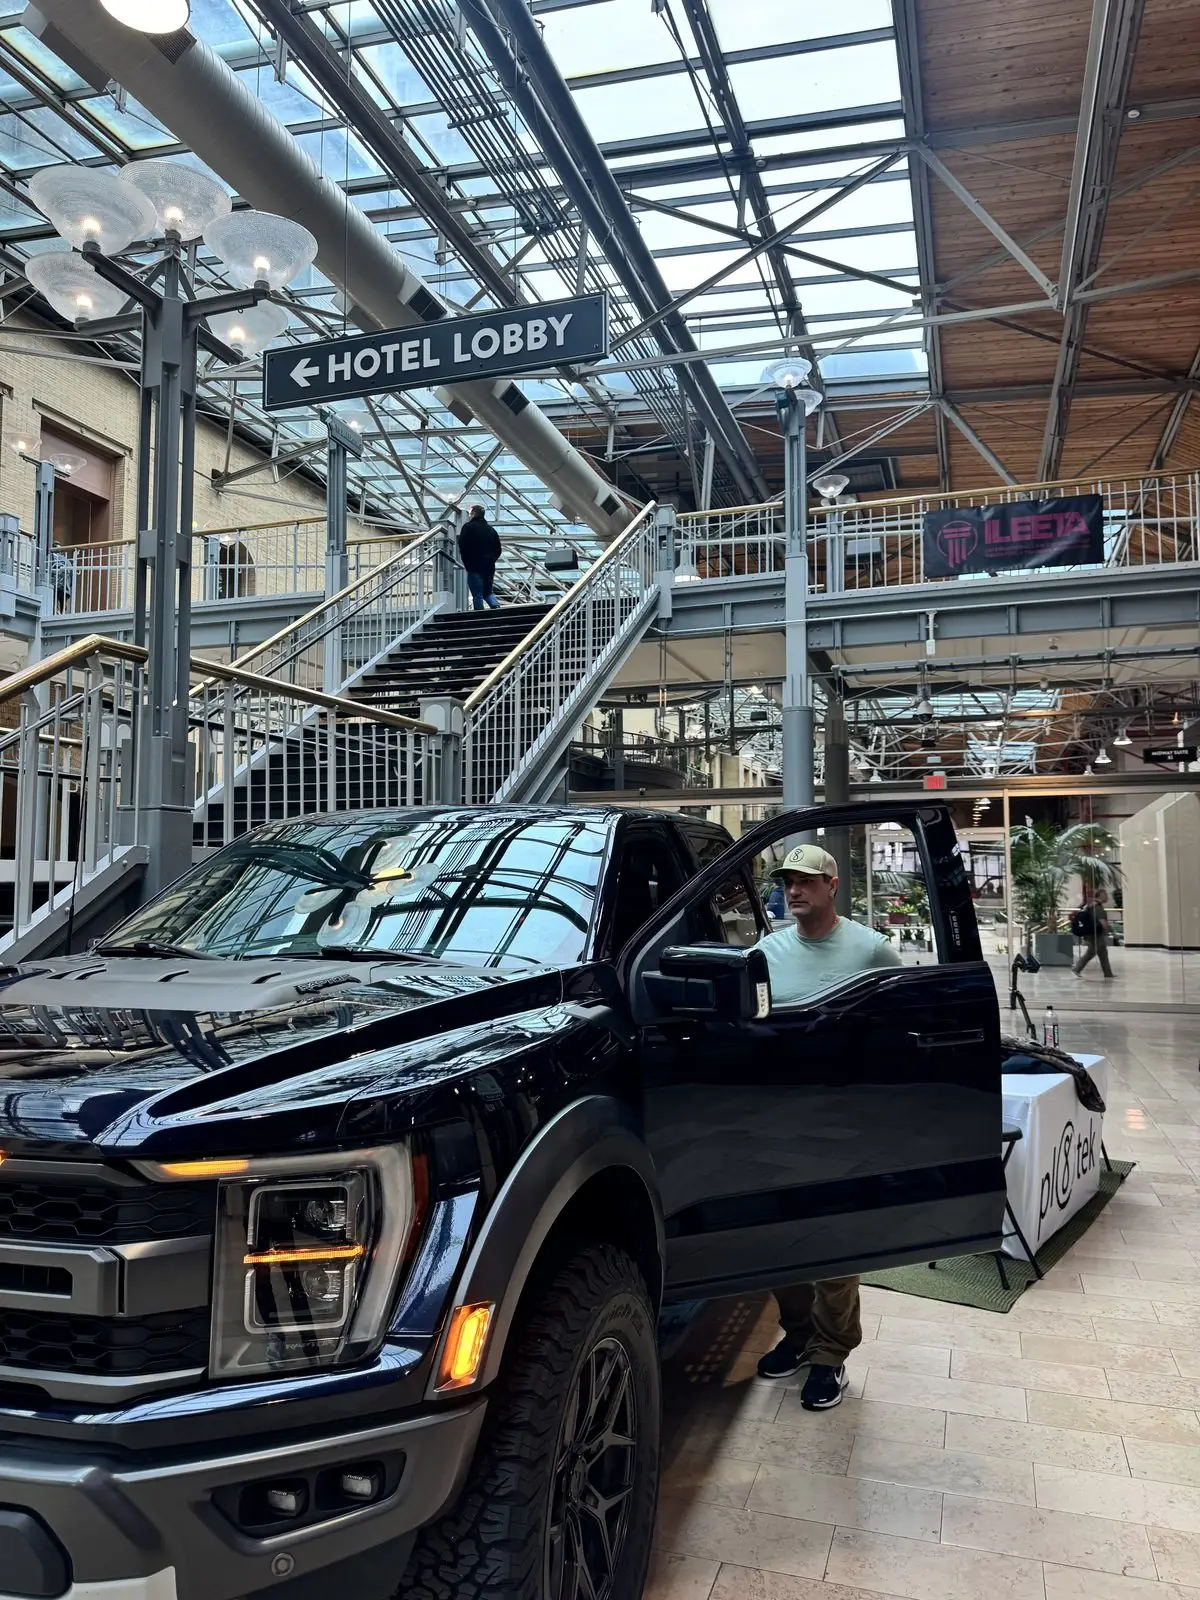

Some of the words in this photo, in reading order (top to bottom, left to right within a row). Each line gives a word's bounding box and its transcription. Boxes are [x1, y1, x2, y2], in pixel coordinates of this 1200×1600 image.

[327, 338, 440, 384] HOTEL
[453, 313, 573, 363] LOBBY
[984, 511, 1091, 544] ILEETA
